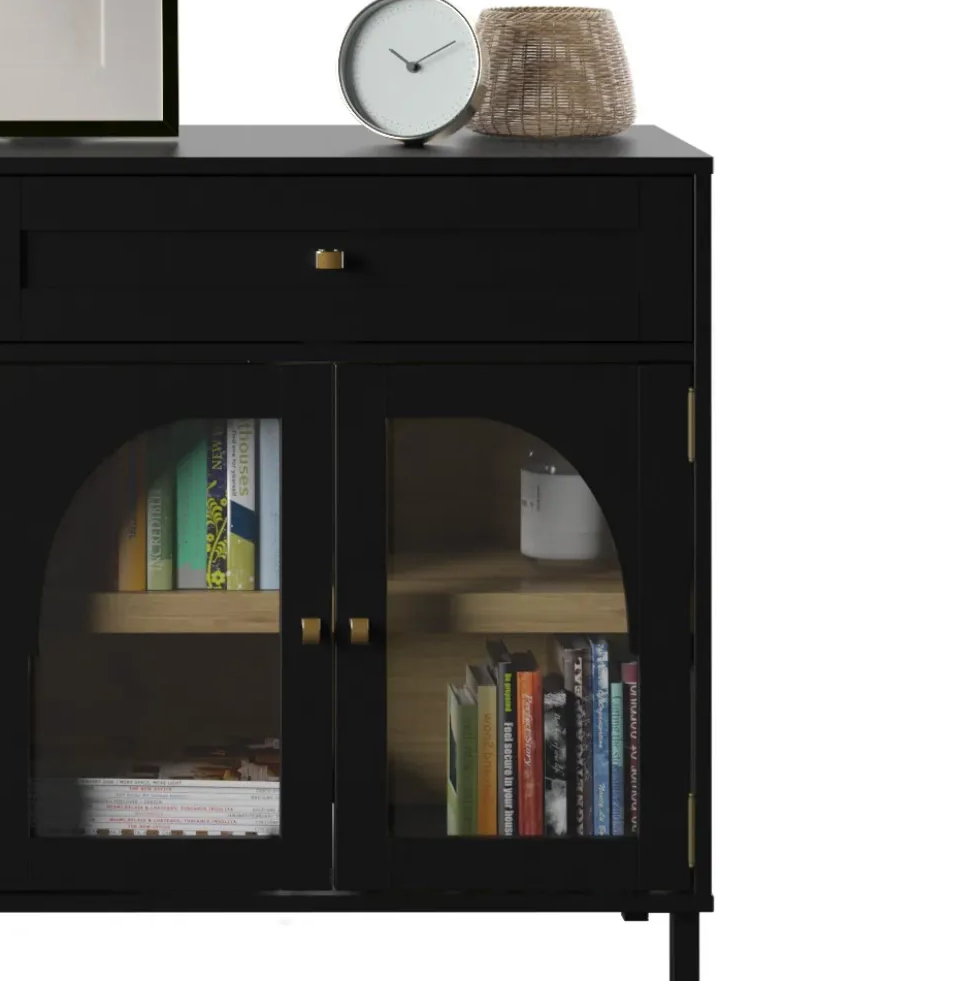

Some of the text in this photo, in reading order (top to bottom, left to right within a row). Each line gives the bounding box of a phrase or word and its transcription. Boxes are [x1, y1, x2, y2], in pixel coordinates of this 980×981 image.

[504, 722, 514, 742] Feel
[504, 743, 512, 776] secure
[523, 735, 532, 767] Story
[504, 777, 514, 786] in
[503, 787, 513, 808] your
